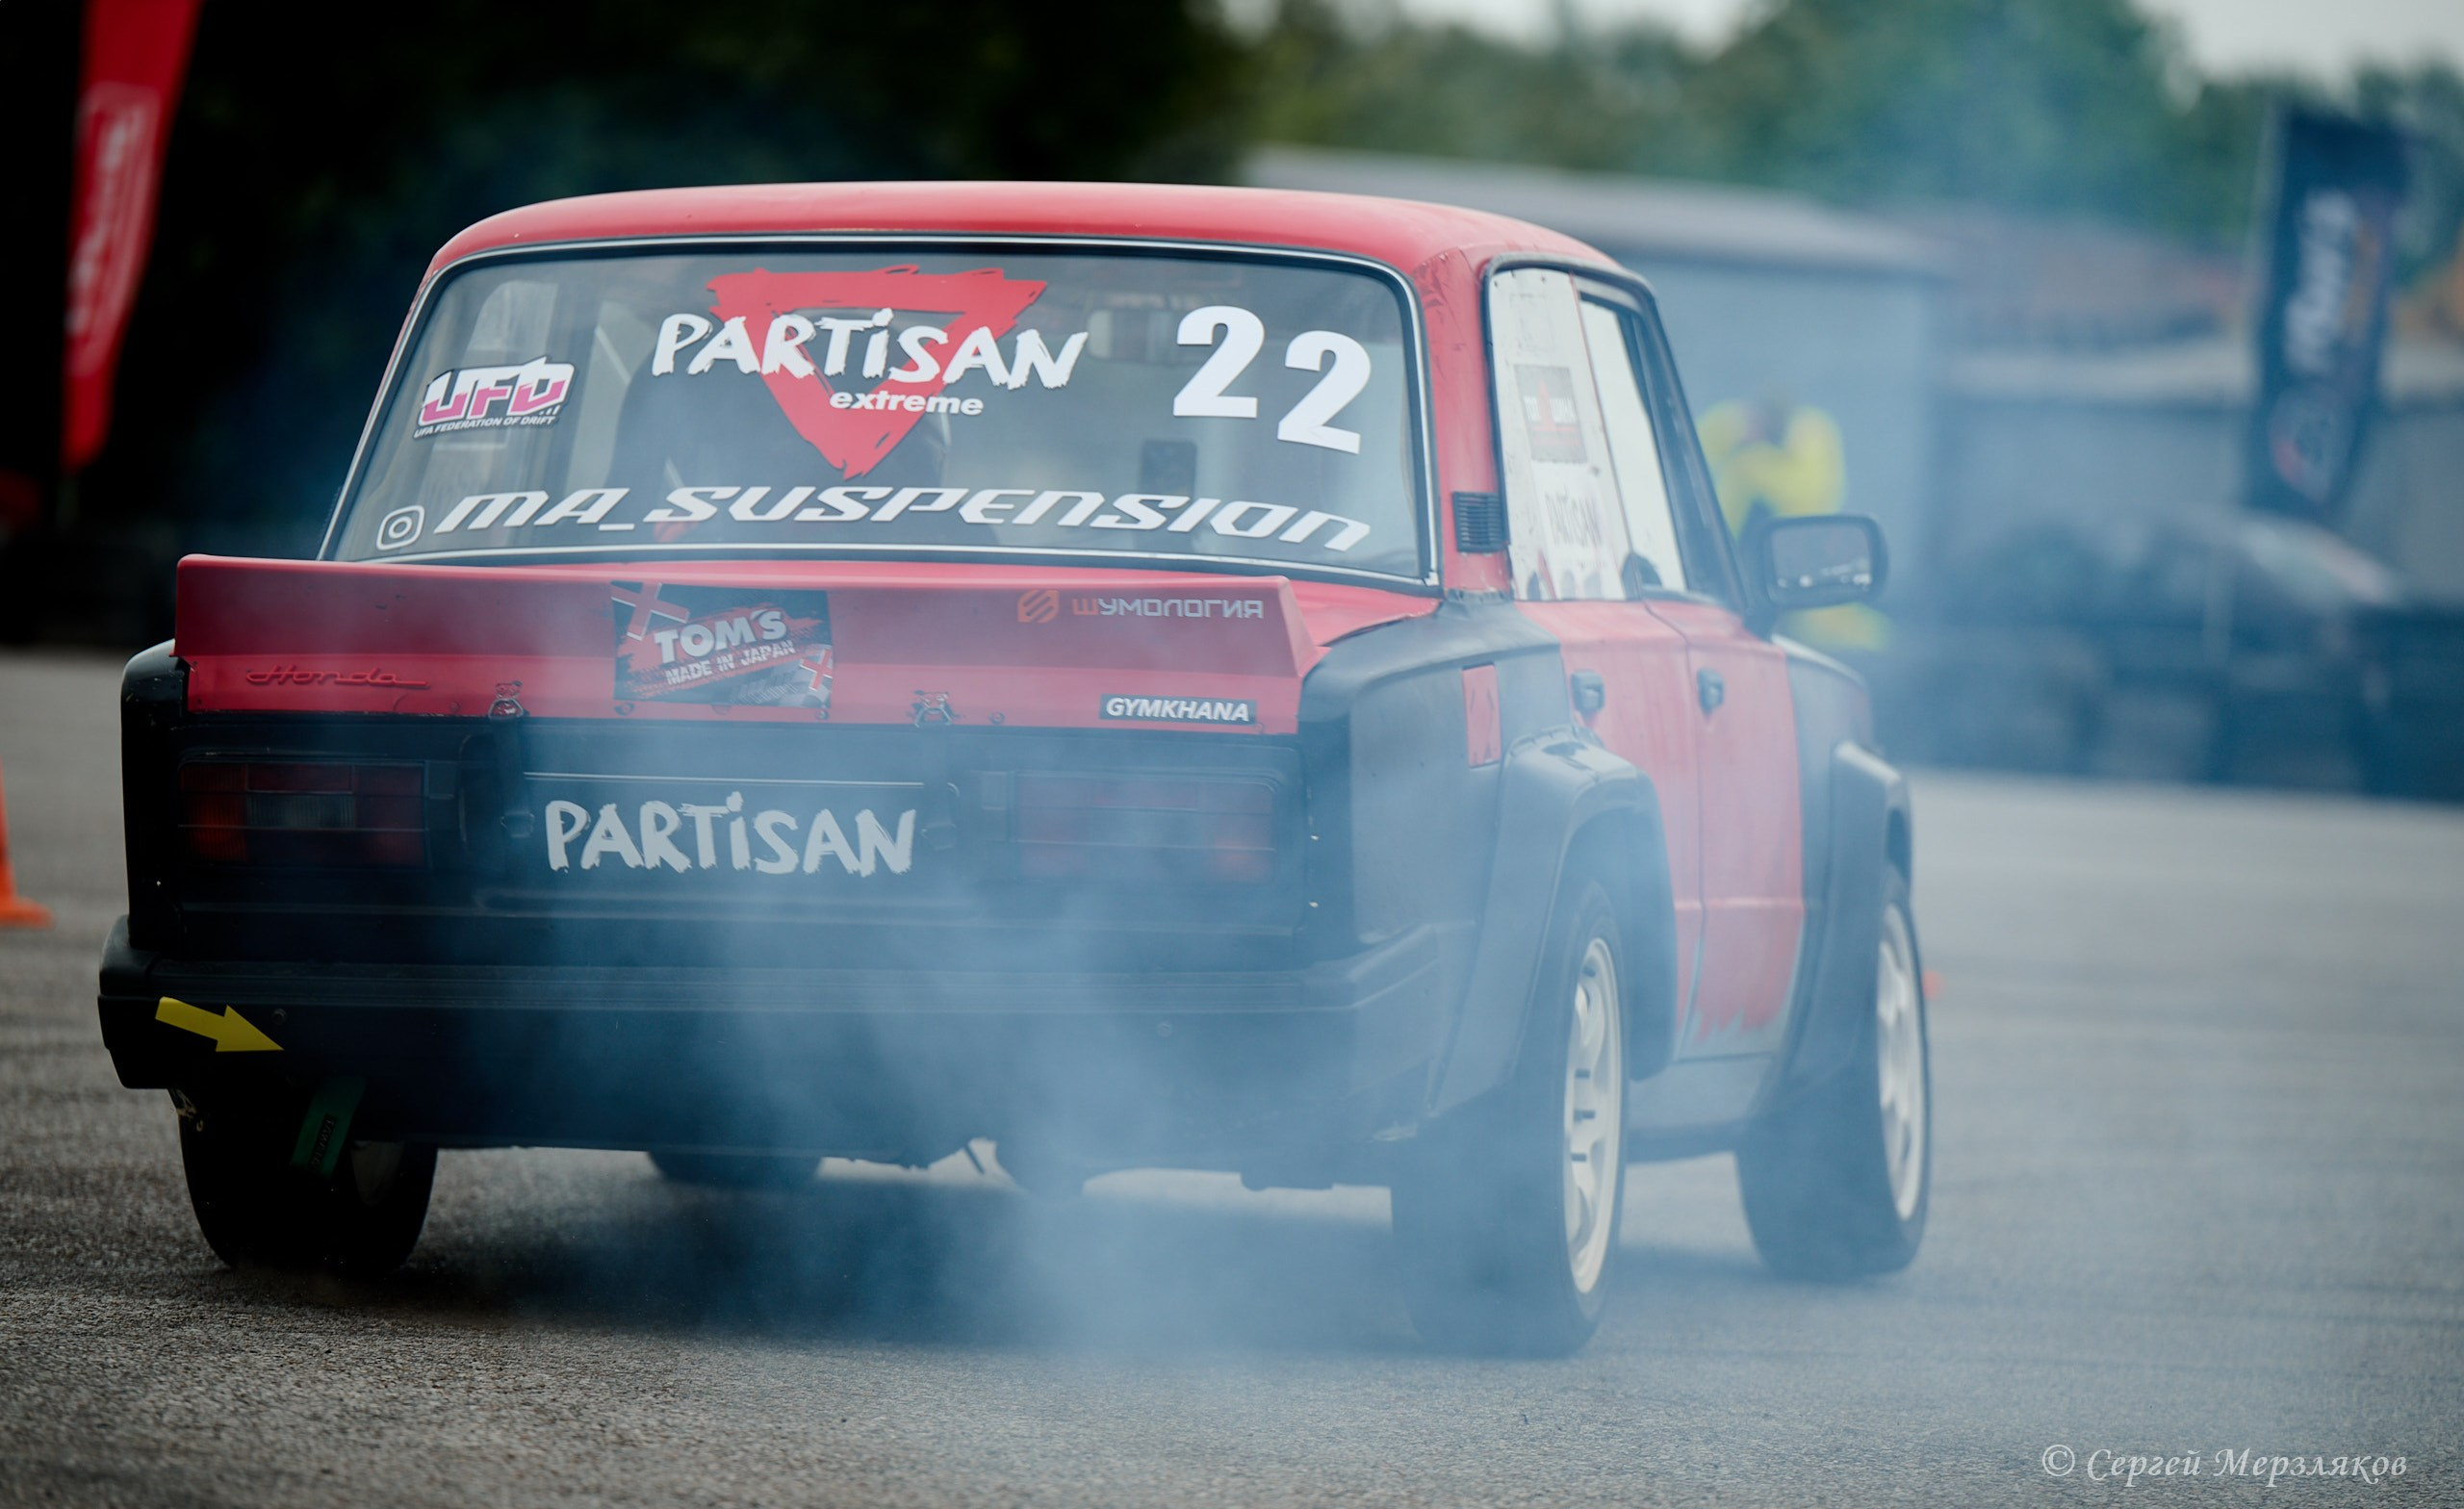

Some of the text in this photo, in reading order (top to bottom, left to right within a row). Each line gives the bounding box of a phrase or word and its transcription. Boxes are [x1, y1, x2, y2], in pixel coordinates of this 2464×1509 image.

[418, 356, 575, 426] UFD
[1173, 305, 1372, 454] 22
[830, 389, 984, 416] extreme
[414, 415, 556, 439] UFA FEDERATION OF DRIFT
[1072, 597, 1265, 620] ШУМОЛОГИЯ
[654, 609, 787, 664] TOM'S
[245, 664, 430, 689] Honda
[665, 640, 796, 686] MADE IN JAPAN
[1105, 697, 1250, 723] GYMKHANA
